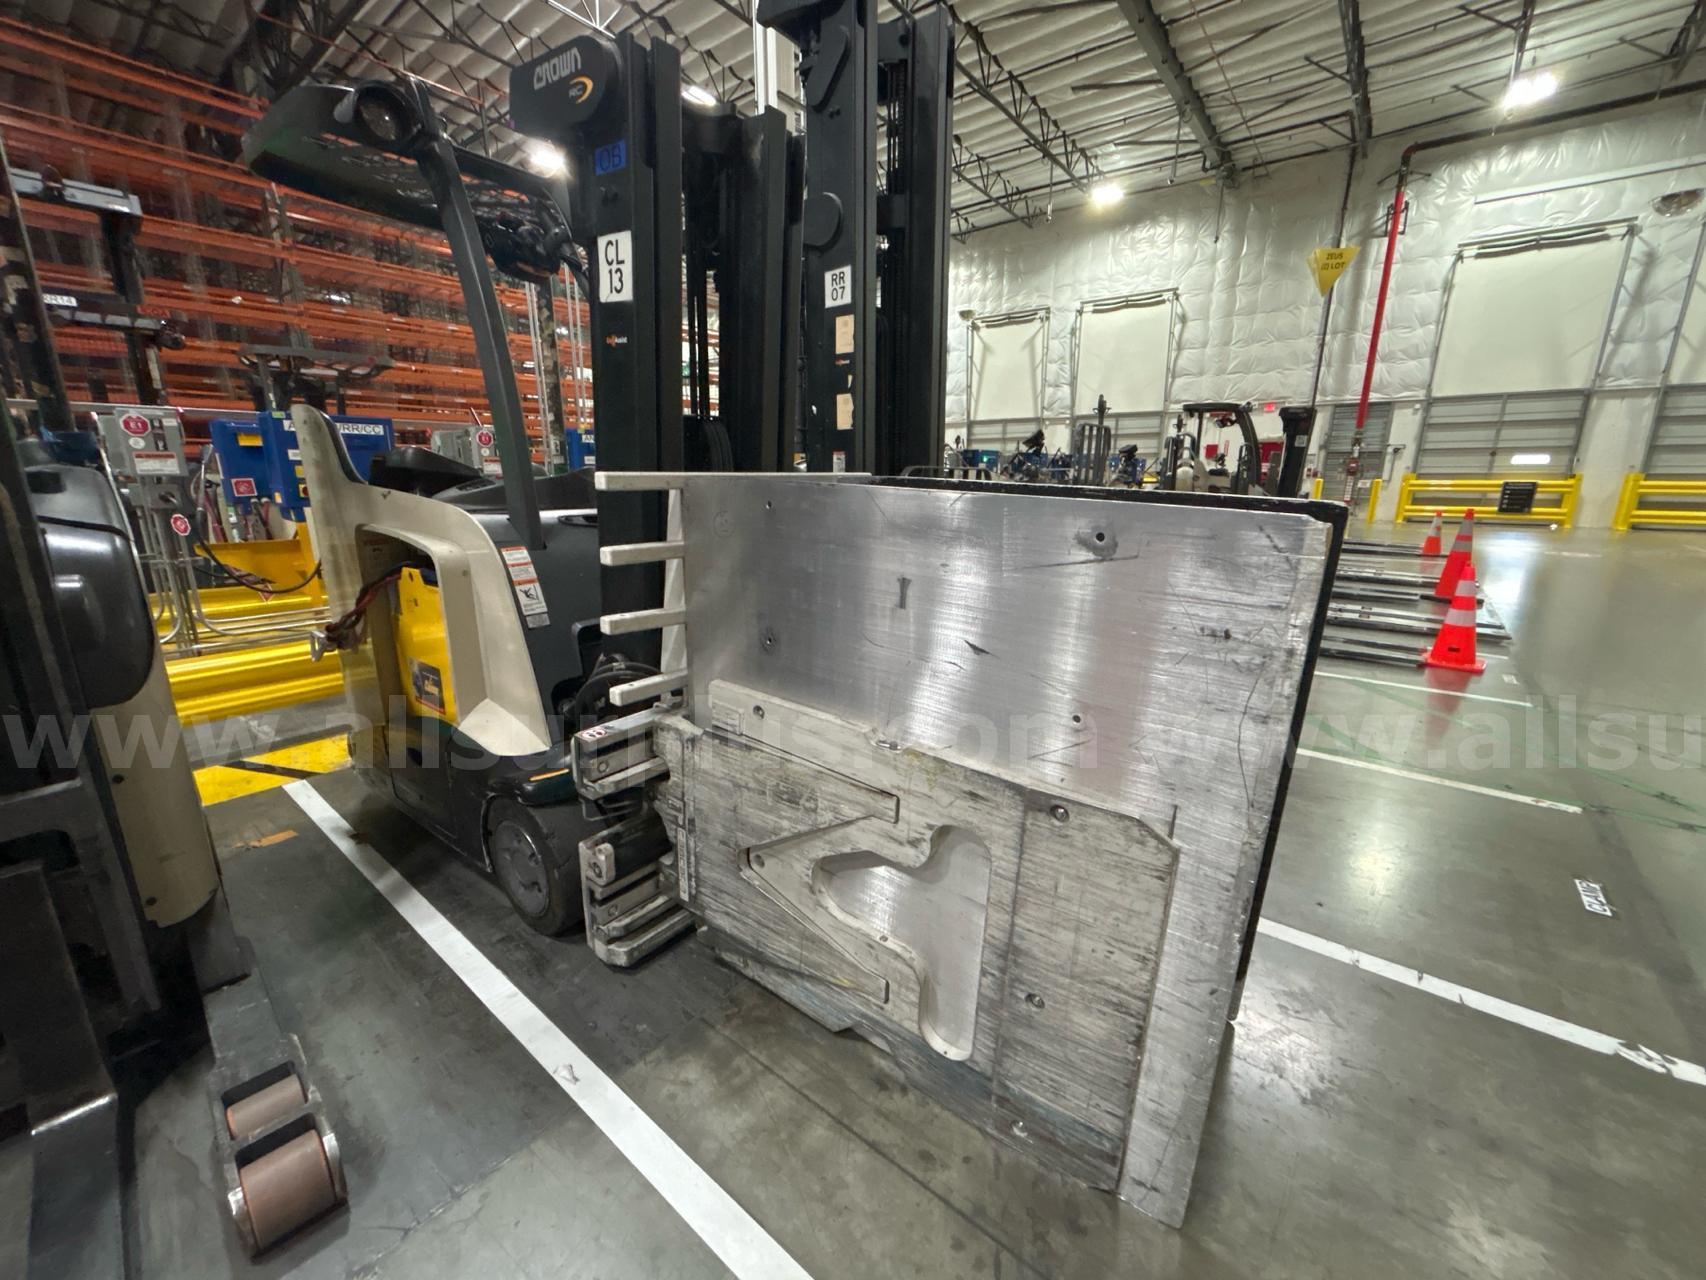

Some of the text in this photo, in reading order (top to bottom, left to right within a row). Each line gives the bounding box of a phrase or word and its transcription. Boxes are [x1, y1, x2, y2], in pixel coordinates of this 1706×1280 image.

[533, 47, 582, 90] CROWN
[605, 239, 625, 266] CL
[607, 267, 624, 294] 13
[831, 271, 846, 287] RR
[831, 286, 846, 301] 07
